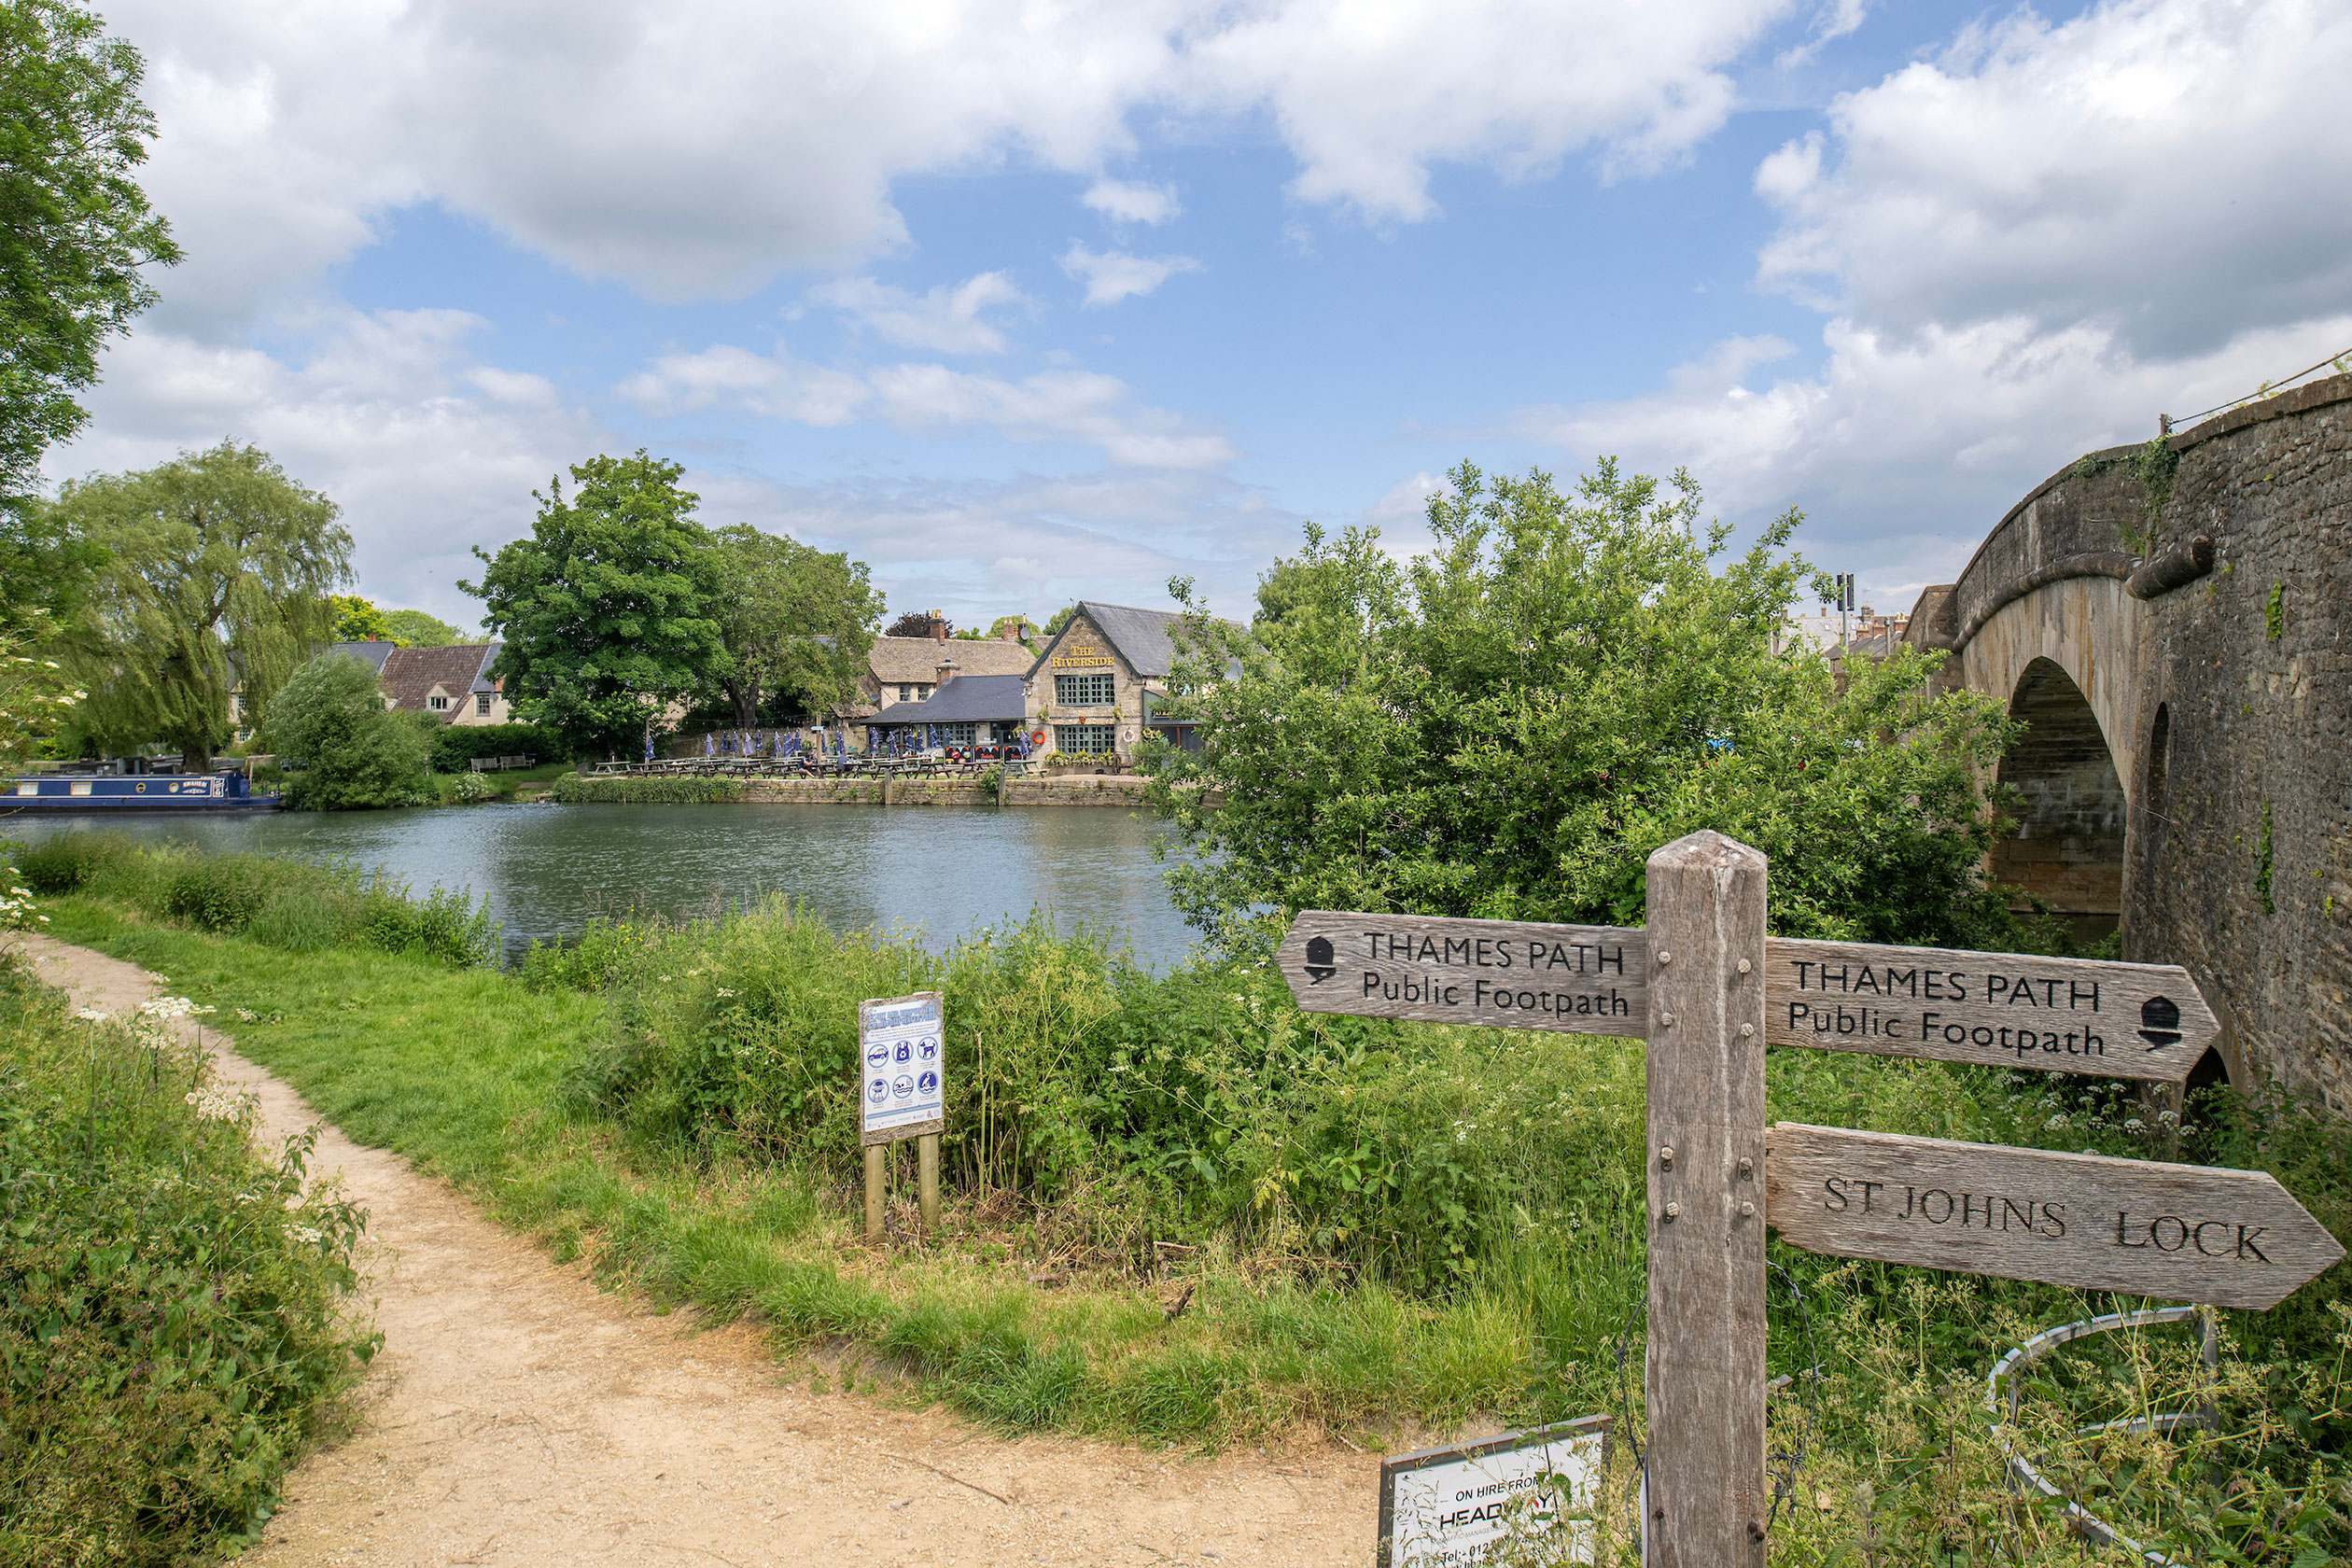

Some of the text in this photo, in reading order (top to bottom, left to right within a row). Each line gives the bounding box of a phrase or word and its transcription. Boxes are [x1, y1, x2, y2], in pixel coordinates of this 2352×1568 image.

[1051, 657, 1114, 667] RIVERSIDE
[1071, 646, 1094, 656] THE
[1364, 932, 1624, 975] THAMES PATH
[1364, 972, 1630, 1018] Public Footpath
[1790, 960, 2100, 1013] THAMES PATH
[1788, 1002, 2105, 1058] Public Footpath
[1825, 1177, 2274, 1264] ST JOHNS LOCK
[1440, 1491, 1553, 1531] HEADY
[1455, 1489, 1473, 1503] ON
[1477, 1482, 1505, 1498] HIRE
